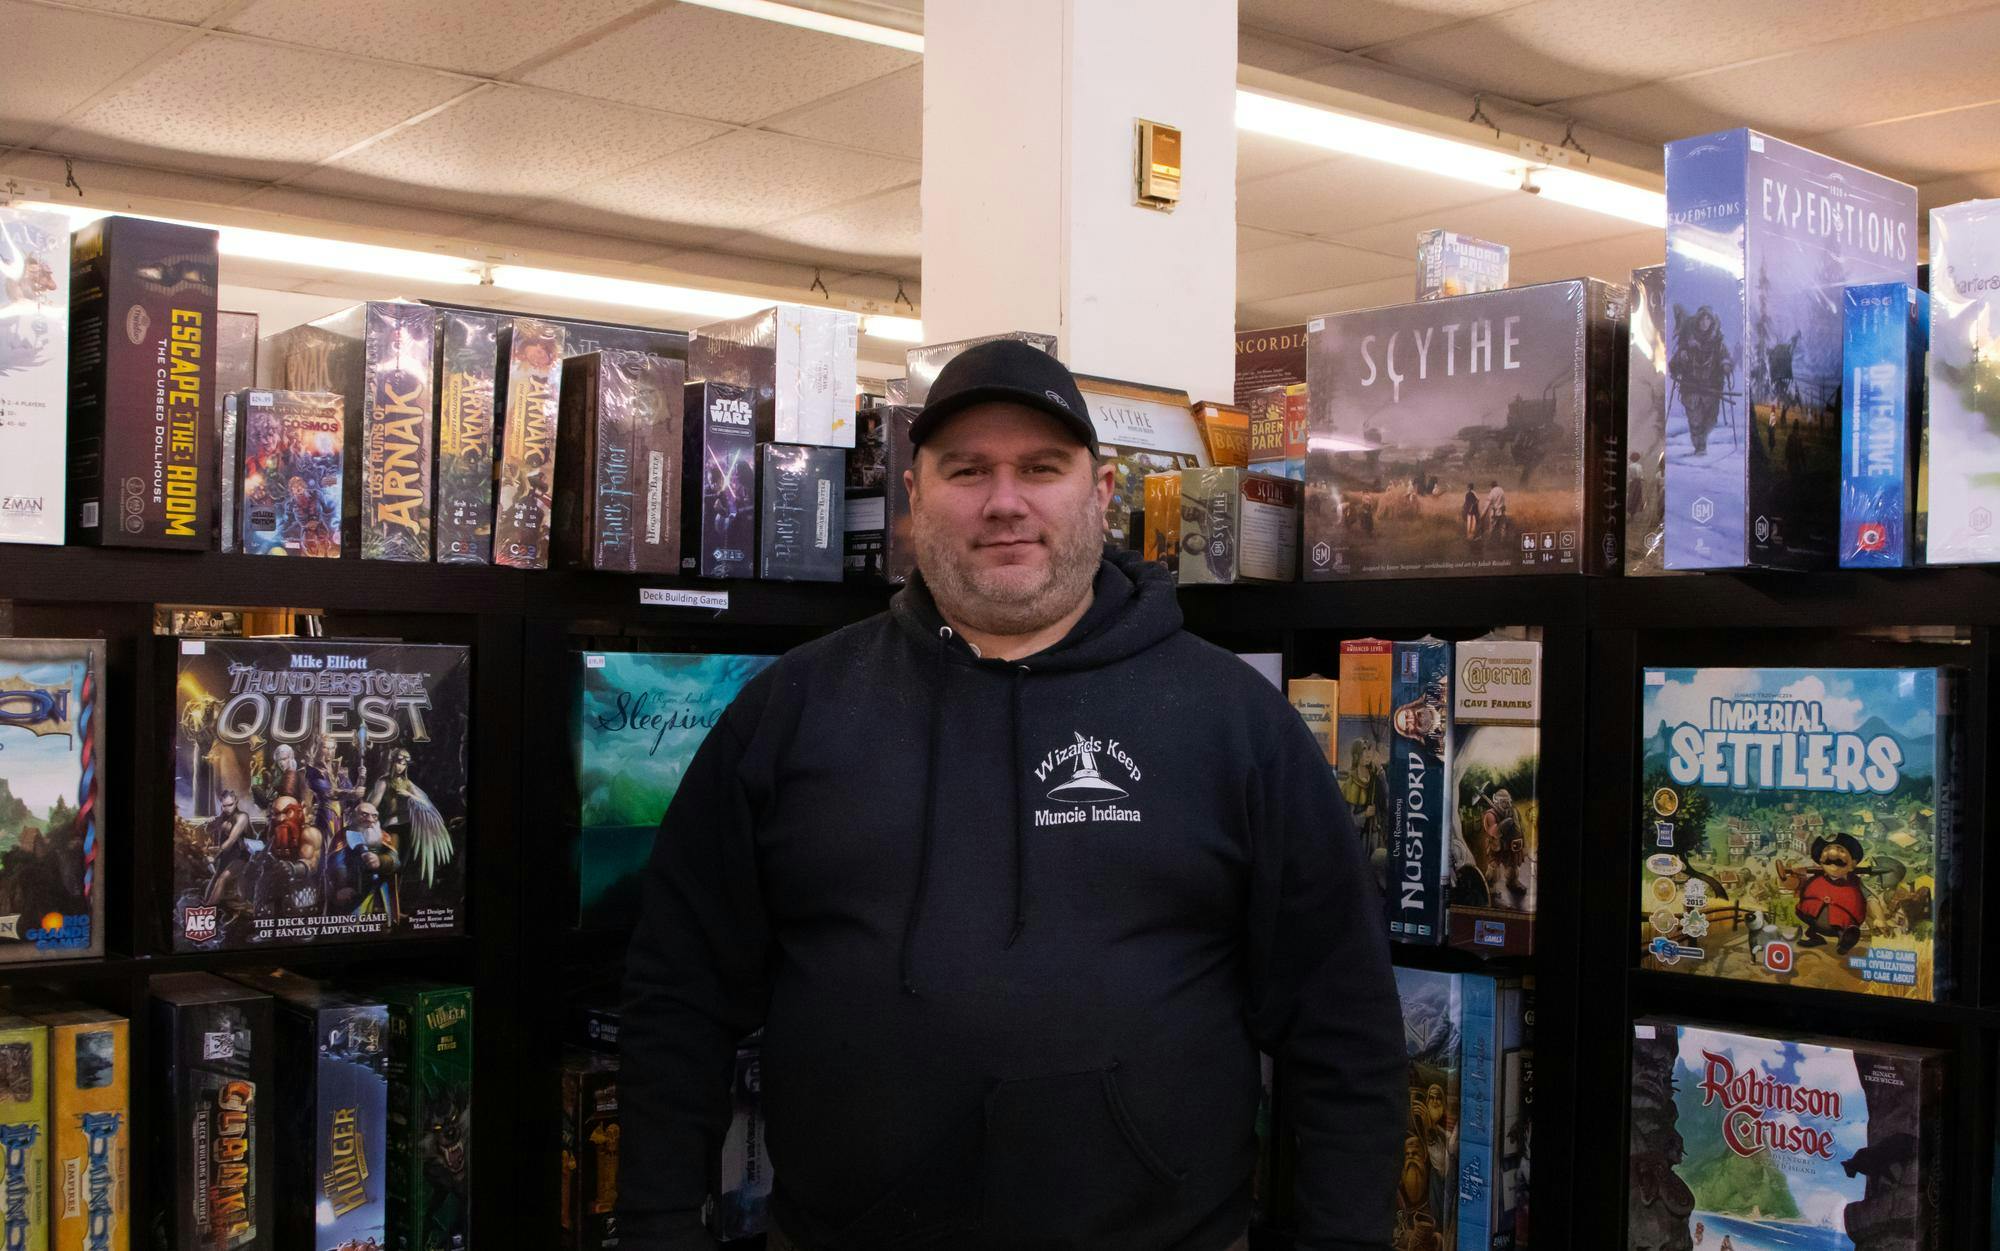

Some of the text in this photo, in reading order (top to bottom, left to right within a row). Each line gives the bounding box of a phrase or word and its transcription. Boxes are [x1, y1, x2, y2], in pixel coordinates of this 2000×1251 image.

[1669, 202, 1740, 225] EXPEDITIONS
[1762, 178, 1906, 261] EXPEDITIONS
[1235, 333, 1309, 354] NCORDIA
[1361, 316, 1521, 403] SCYTHE
[461, 372, 483, 460] ARNAK
[524, 376, 549, 463] ARNAK
[710, 410, 752, 426] WARS
[711, 399, 752, 413] STAR
[1099, 406, 1152, 429] SCYTHE
[153, 338, 167, 503] THE CURSED DOLLHOUSE
[165, 308, 202, 537] ESCAPE THE ROOM
[282, 420, 338, 433] COSMOS
[371, 404, 386, 498] LOST RUINS OF
[1251, 433, 1283, 450] PARK
[377, 382, 424, 536] ARNAK
[1211, 491, 1228, 540] SCYTHE
[1757, 520, 1767, 537] SM
[1315, 548, 1328, 561] SM
[643, 591, 728, 606] Deck Building Games
[290, 654, 368, 669] Mike Elliott
[1461, 656, 1532, 693] Caverna
[228, 664, 425, 695] THUNDERSTONE
[1464, 699, 1532, 709] CAVE FARMERS
[1711, 698, 1824, 732] IMPERIAL
[217, 692, 432, 749] QUEST
[1034, 736, 1141, 782] Wizards Keep
[1670, 726, 1902, 792] SETTLERS
[1035, 805, 1141, 826] Muncie Indiana
[1393, 798, 1404, 841] Rosenberg
[1401, 751, 1431, 912] NUSFJORD
[26, 925, 90, 941] GRANDE
[63, 914, 90, 926] RIO
[186, 915, 216, 931] AEG
[253, 913, 387, 928] THE DECK BUILDING GAME
[259, 924, 382, 938] OF FANTASY ADVENTURE
[35, 938, 90, 949] GAMES
[1876, 949, 1893, 959] CARD
[1895, 951, 1916, 961] GAME
[1849, 958, 1916, 973] WITH CIVILIZATIONS
[1863, 970, 1916, 984] TO CARE ABOUT
[425, 1003, 467, 1030] HUNGER
[1697, 1047, 1842, 1121] Robinson
[1721, 1103, 1835, 1160] Crusoe
[333, 1107, 371, 1217] HUNGER
[66, 1163, 76, 1217] EMPIRES
[323, 1169, 335, 1199] THE
